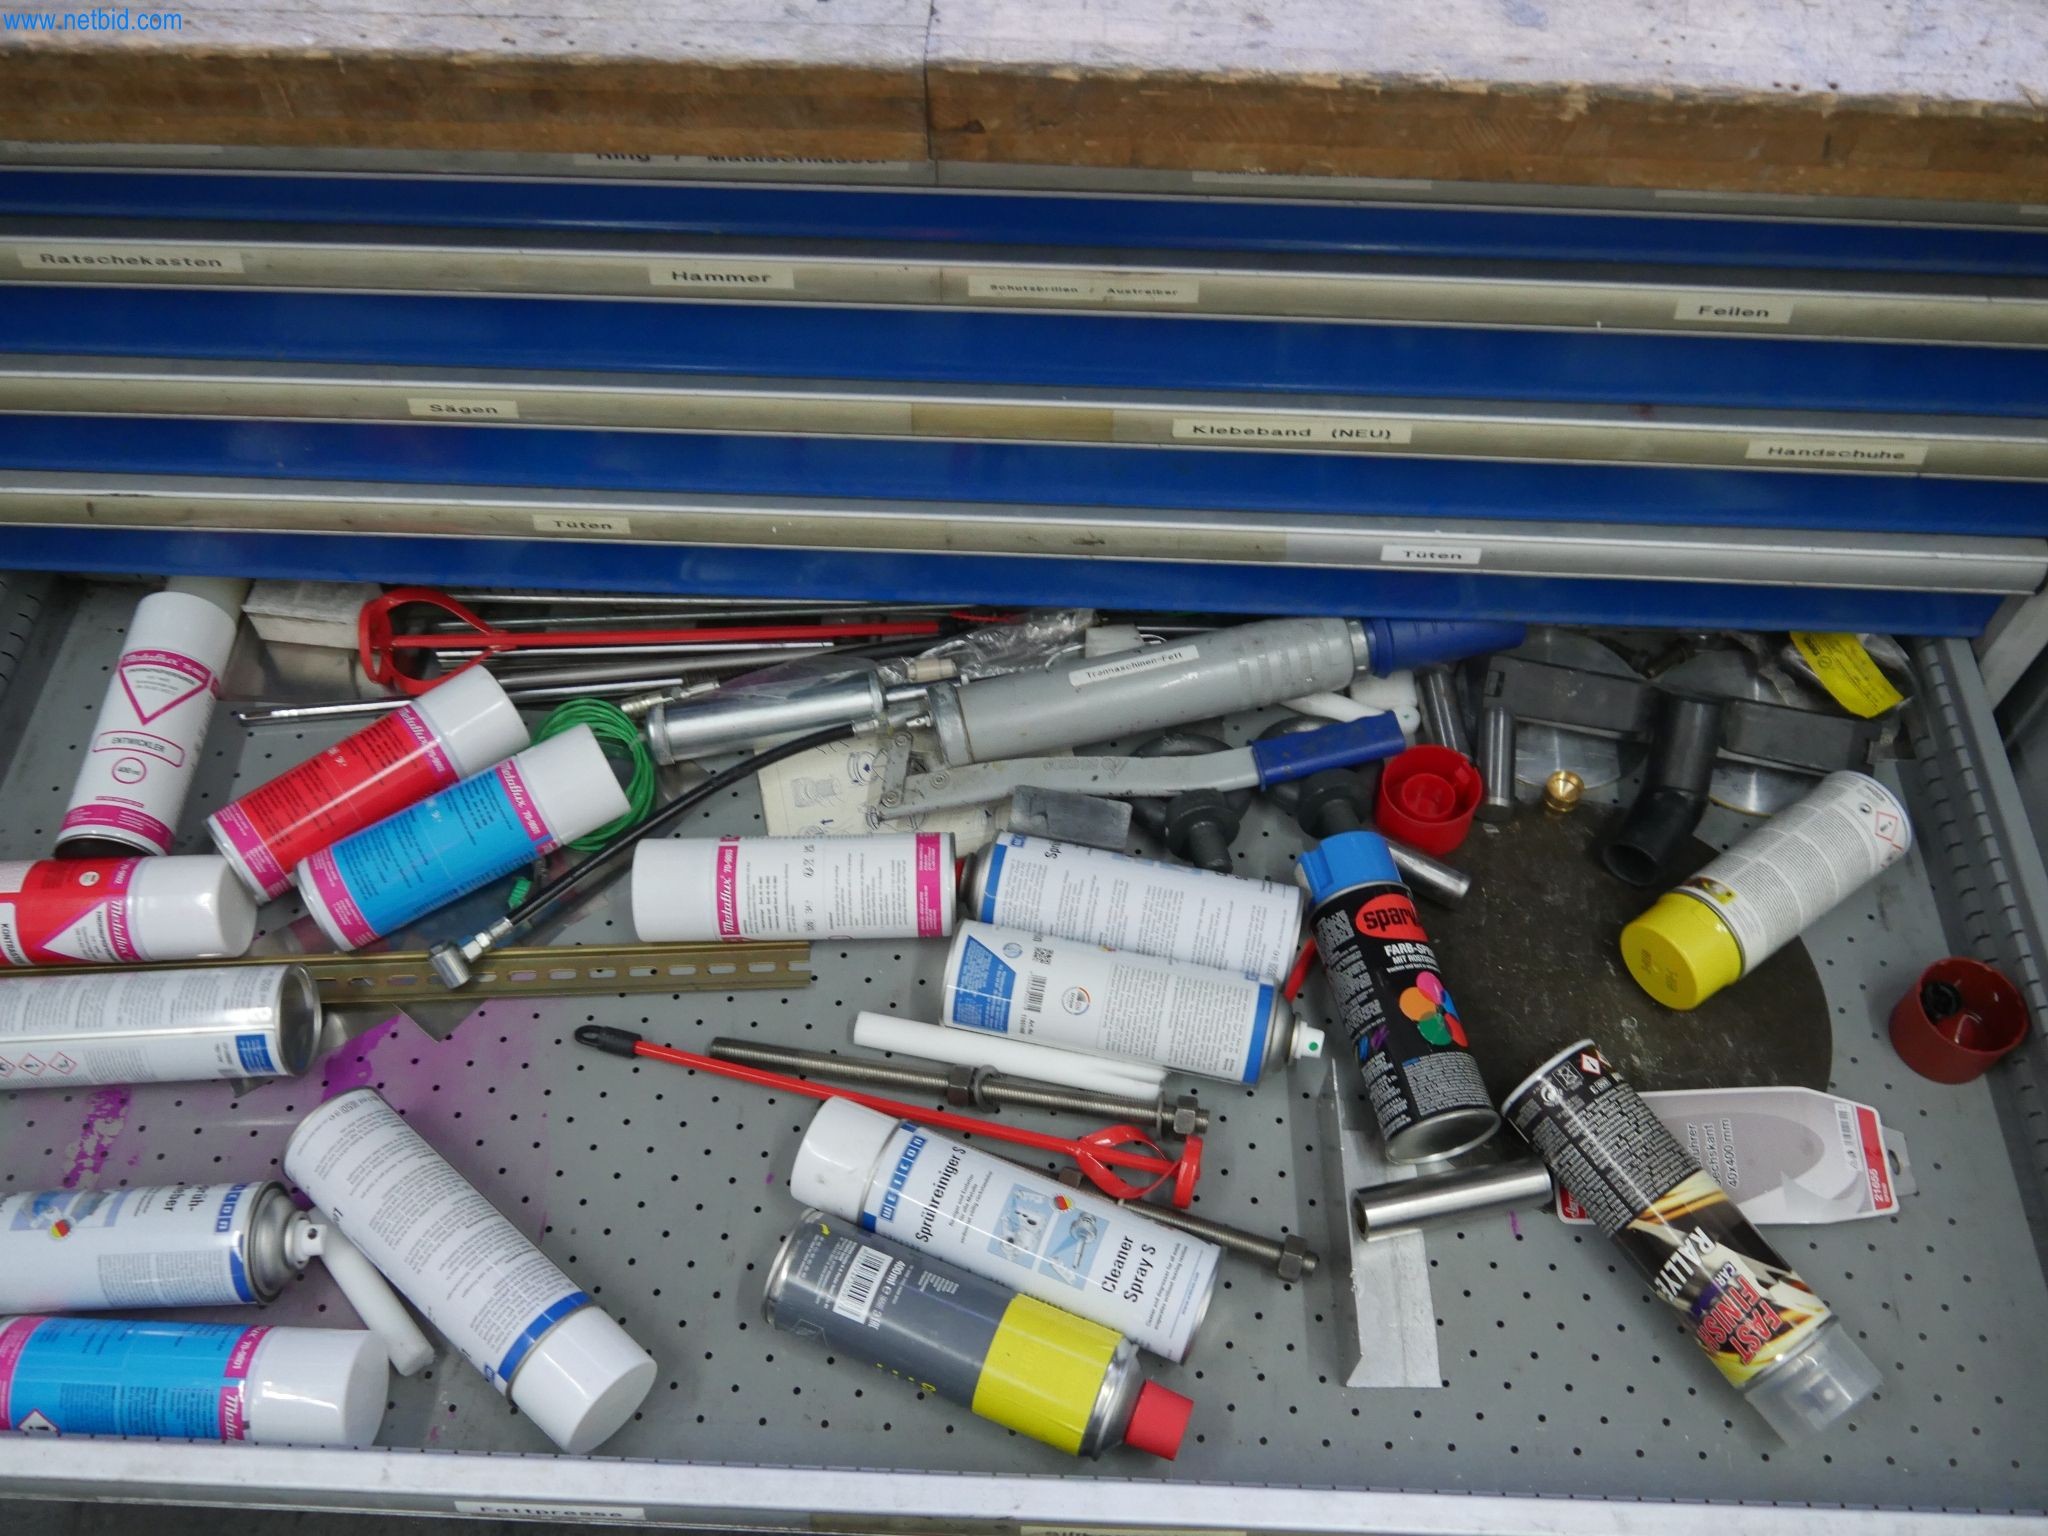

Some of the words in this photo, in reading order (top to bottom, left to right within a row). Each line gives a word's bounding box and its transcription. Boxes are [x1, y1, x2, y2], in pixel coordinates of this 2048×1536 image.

[39, 253, 223, 268] Ratschekasten
[671, 270, 772, 283] Hammer
[1698, 305, 1769, 318] Feilen
[1192, 425, 1312, 438] Klebeband
[1331, 428, 1392, 441] (NEU)
[1767, 446, 1905, 460] Handschuhe
[719, 876, 734, 933] Metaflux
[1720, 1118, 1732, 1138] mm
[915, 1155, 962, 1243] Sprühreiniger
[952, 1145, 967, 1155] S
[1101, 1235, 1134, 1293] Cleaner
[1123, 1257, 1154, 1303] Spray
[1141, 1243, 1156, 1255] S
[1653, 1226, 1716, 1303] RALLYE
[1696, 1274, 1761, 1355] FINISH
[1728, 1299, 1783, 1367] FAST
